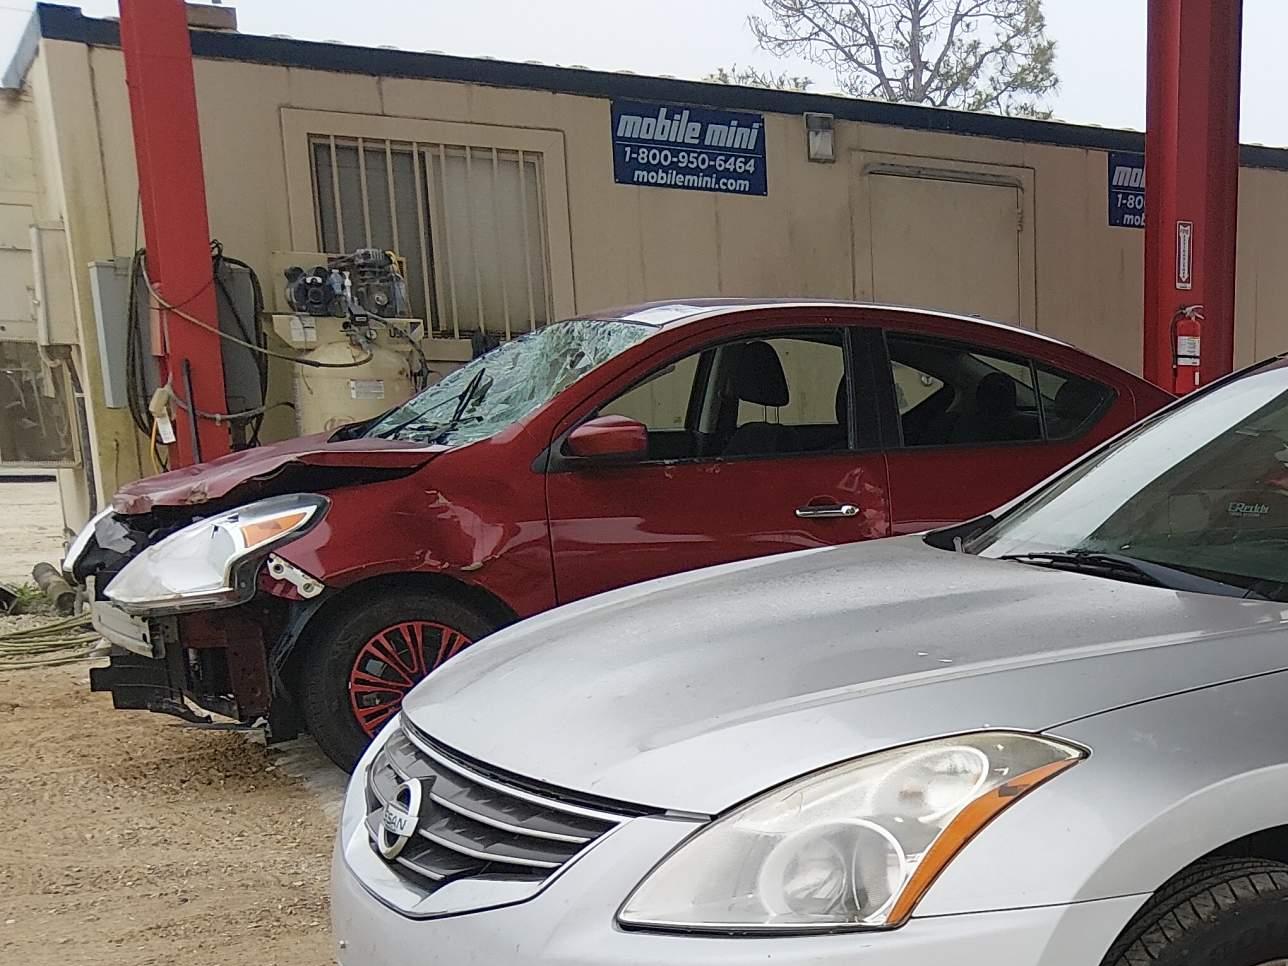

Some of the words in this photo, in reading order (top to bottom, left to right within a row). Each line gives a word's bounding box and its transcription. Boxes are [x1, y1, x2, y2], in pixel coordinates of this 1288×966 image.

[616, 107, 701, 145] mobile
[704, 120, 761, 150] mini
[624, 147, 756, 174] 1-800-950-6464
[633, 169, 750, 192] mobilemini.com
[1117, 194, 1145, 209] 1-80
